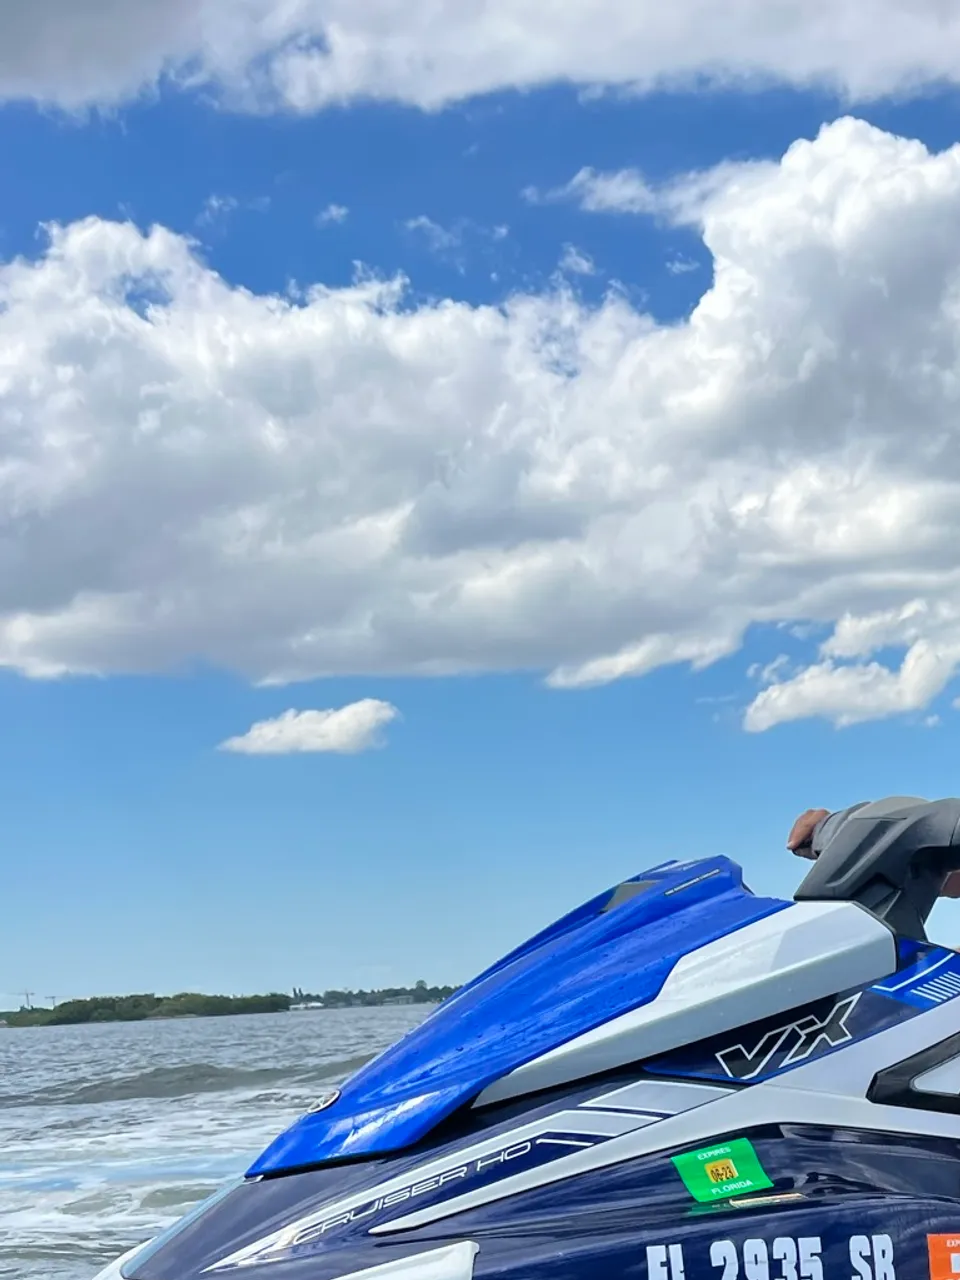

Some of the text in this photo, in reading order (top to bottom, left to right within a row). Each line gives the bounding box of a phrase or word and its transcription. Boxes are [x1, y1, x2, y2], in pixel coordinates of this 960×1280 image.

[715, 991, 863, 1080] VX
[697, 1146, 732, 1161] EXPIRES
[293, 1141, 532, 1245] CRUISER HO
[711, 1179, 754, 1195] FLORIDA
